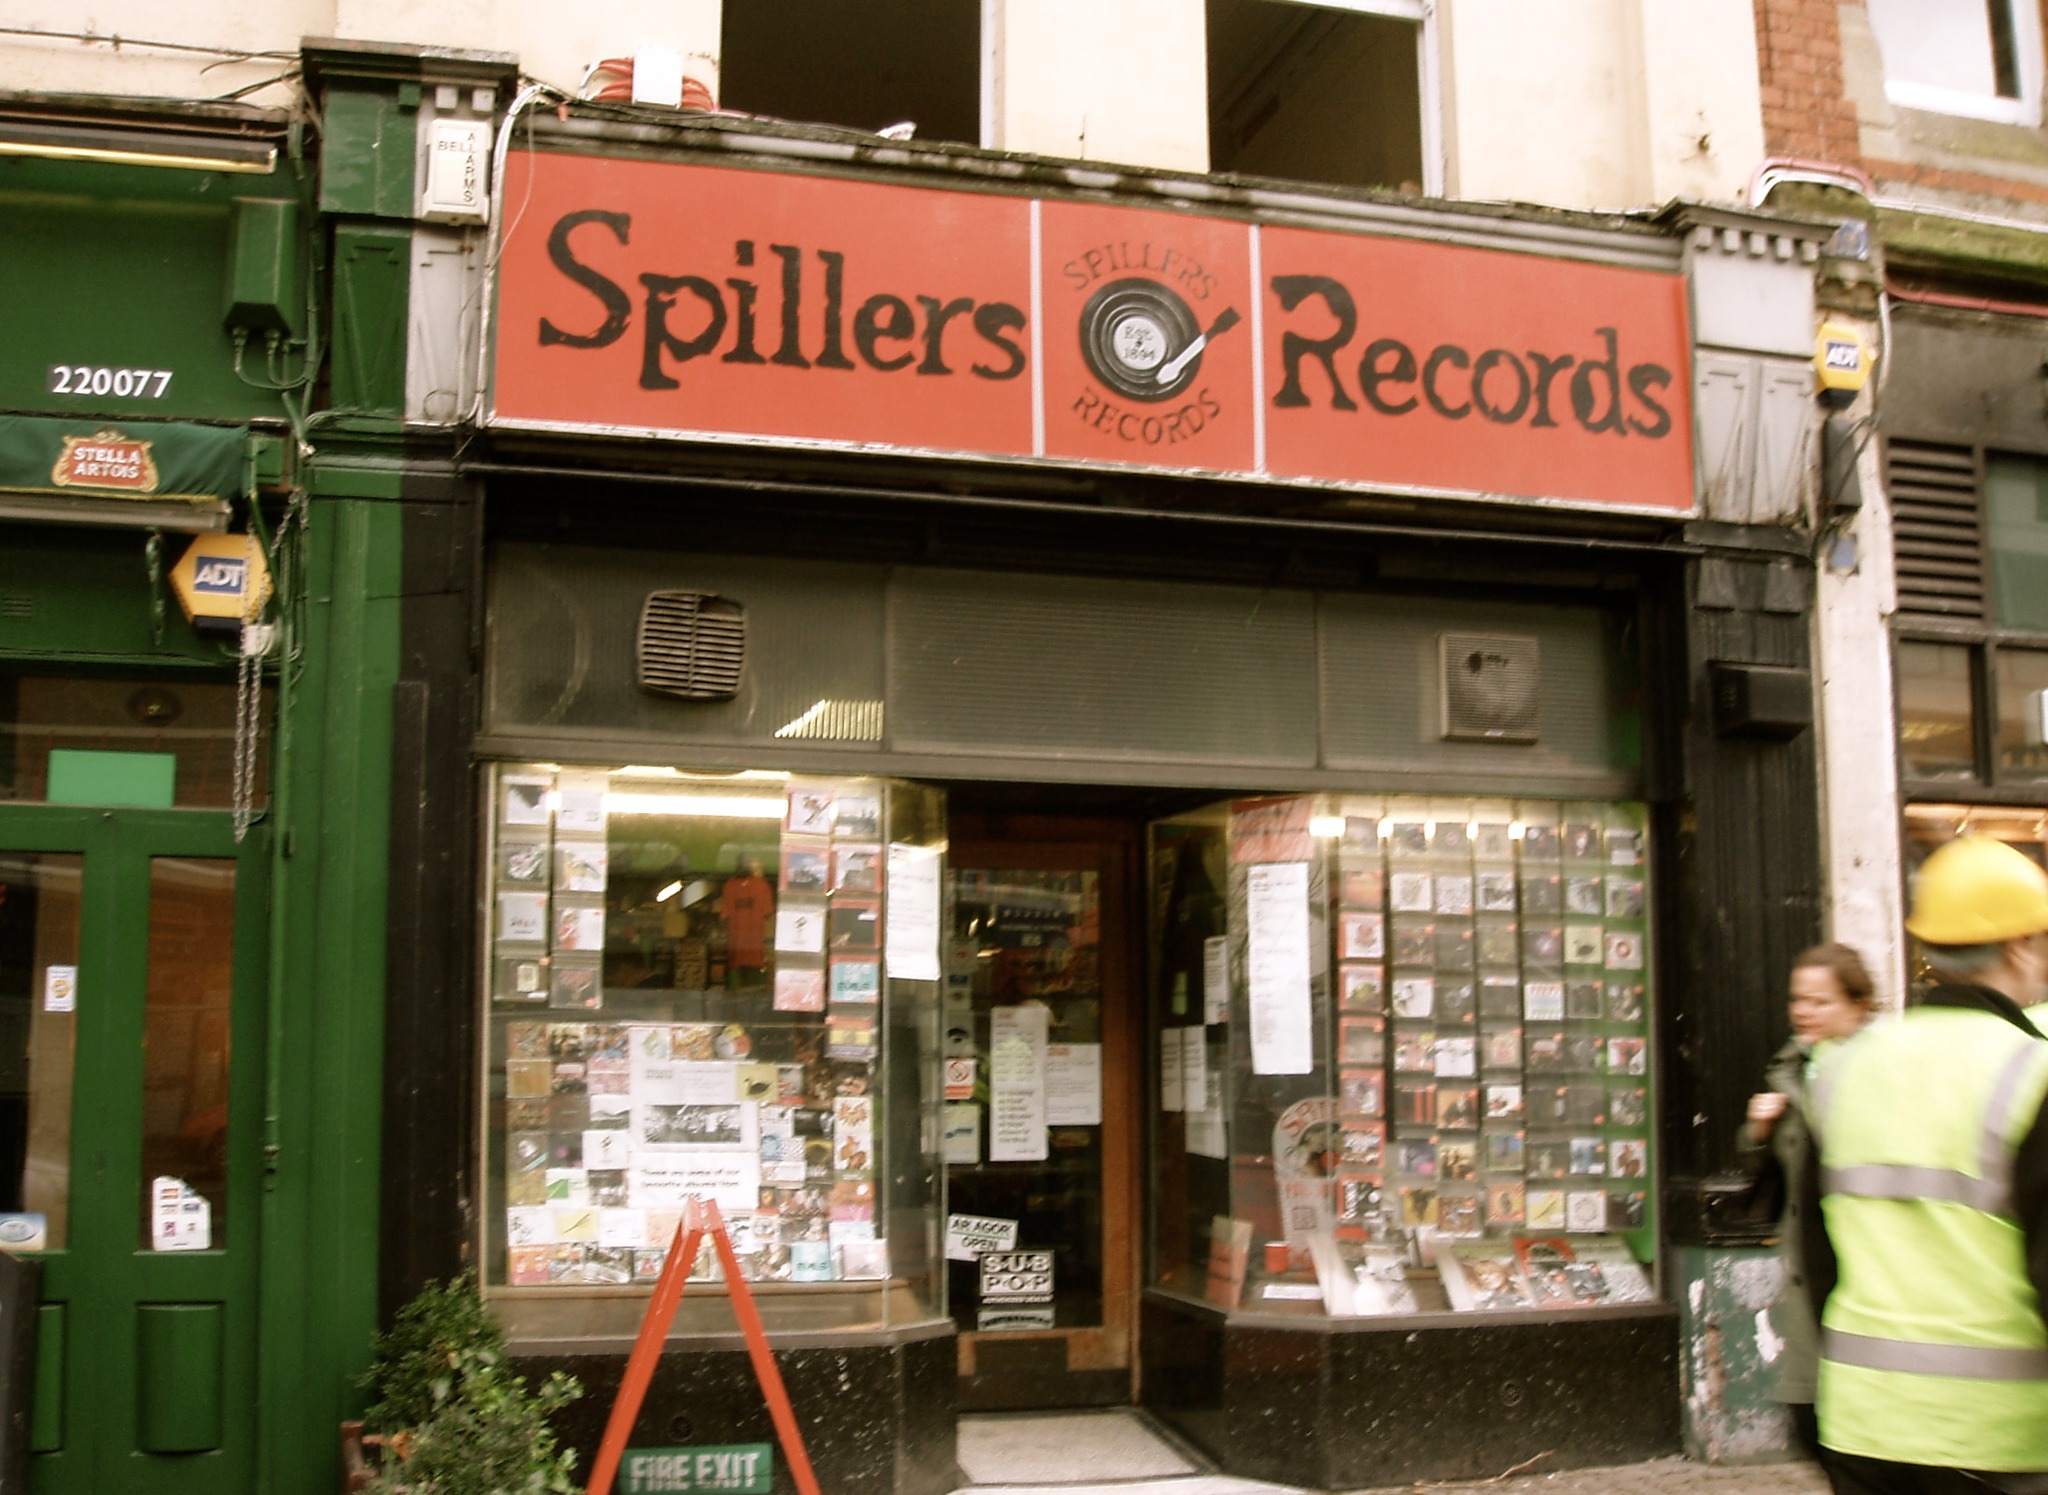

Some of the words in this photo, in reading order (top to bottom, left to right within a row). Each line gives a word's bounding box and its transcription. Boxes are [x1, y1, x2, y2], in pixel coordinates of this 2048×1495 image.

[1063, 242, 1218, 300] SPILLERS
[538, 209, 1027, 390] Spillers
[1271, 274, 1674, 438] Records
[52, 366, 173, 398] 220077
[1072, 387, 1221, 444] RECORDS
[74, 447, 141, 464] STELLA
[74, 461, 139, 478] ARTOIS
[194, 564, 247, 587] ADT
[962, 1236, 998, 1251] OPEN
[629, 1454, 691, 1492] FIRE
[695, 1451, 760, 1488] EXIT
